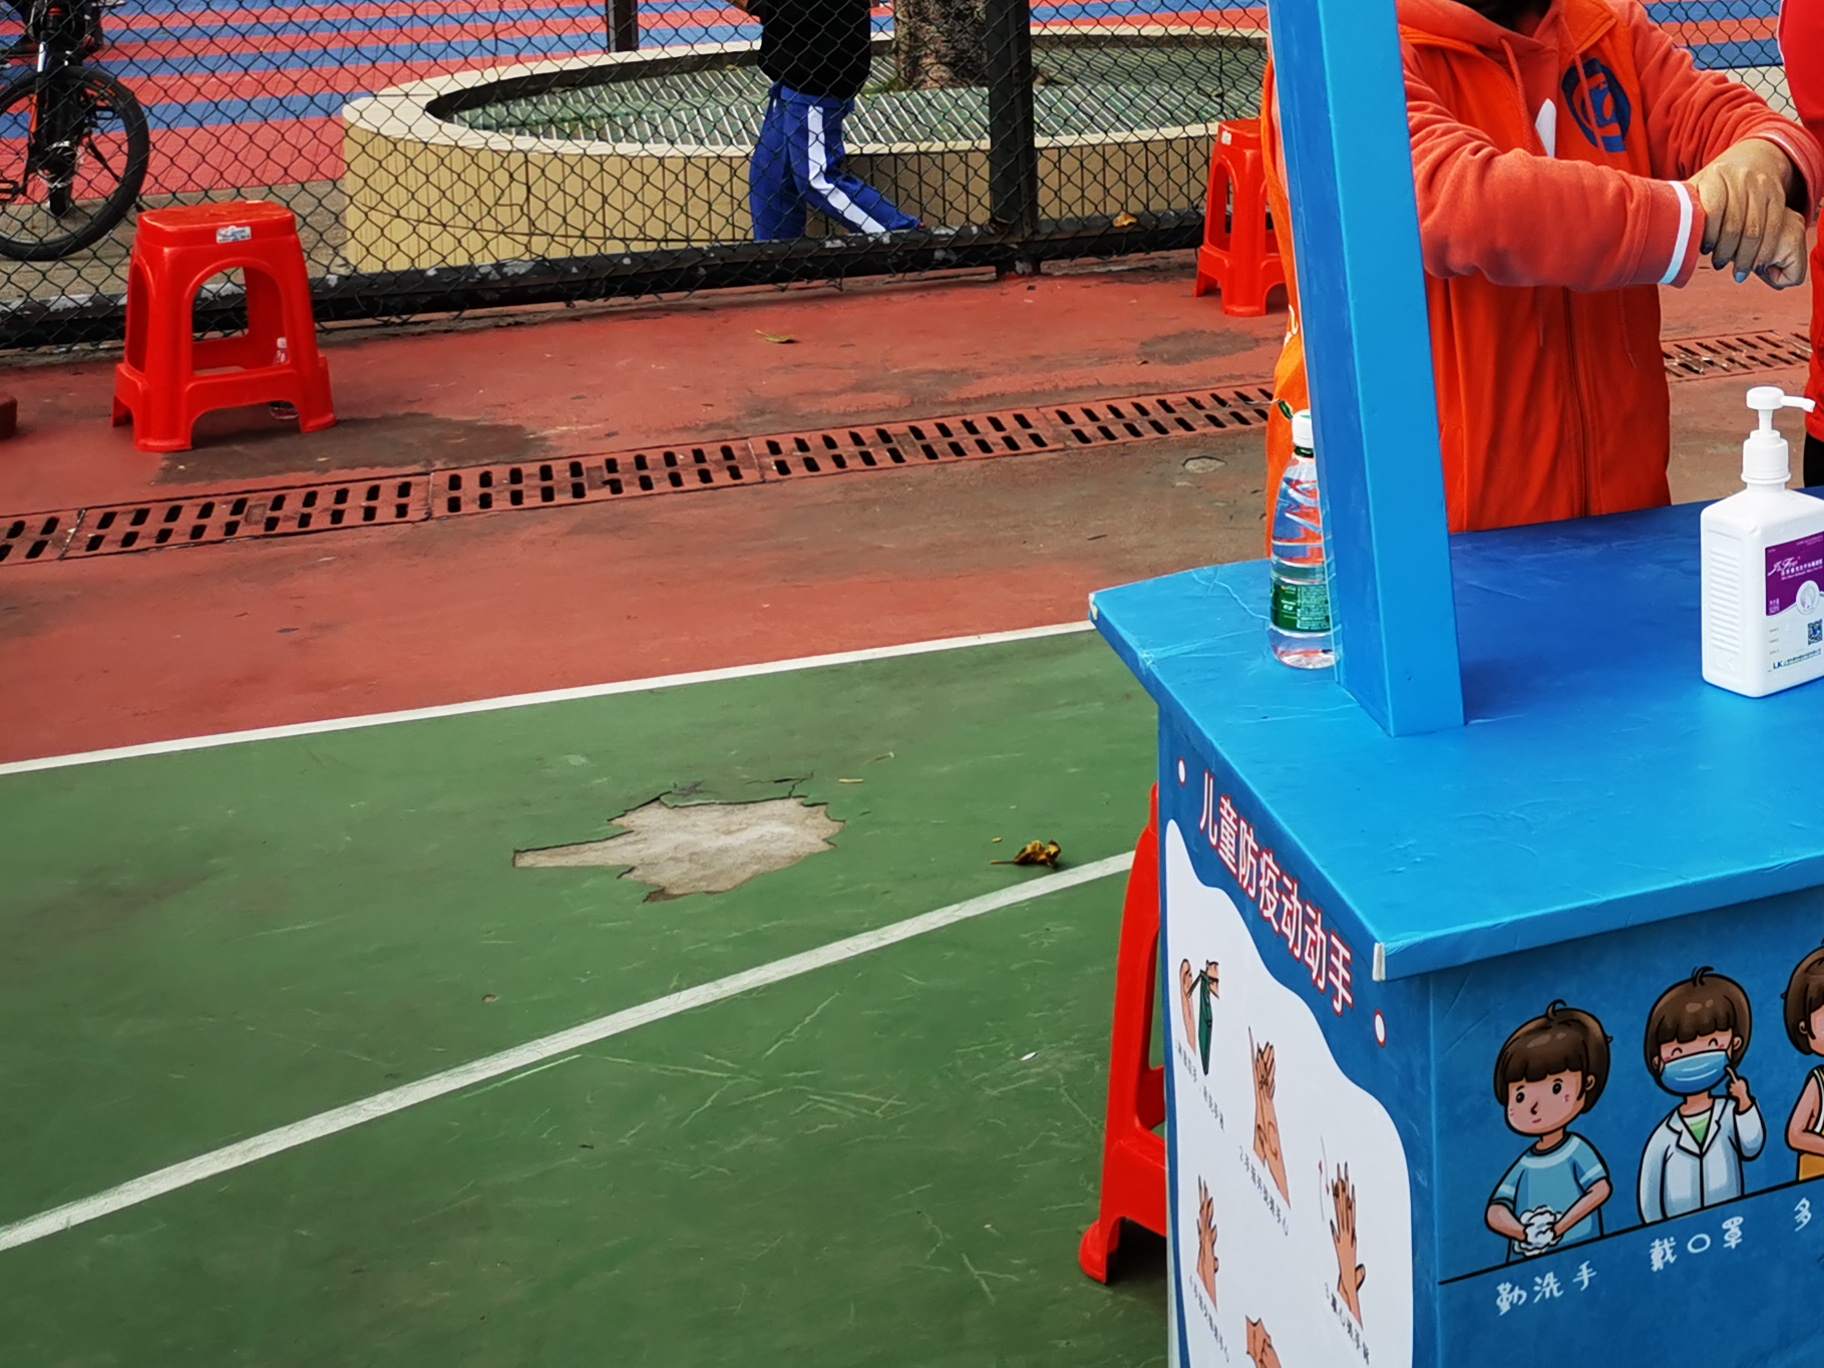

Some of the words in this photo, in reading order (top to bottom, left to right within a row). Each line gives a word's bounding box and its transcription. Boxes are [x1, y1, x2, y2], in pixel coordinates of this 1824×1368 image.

[1199, 770, 1356, 1018] 儿童防疫动动手
[1496, 1261, 1597, 1316] 勤洗手
